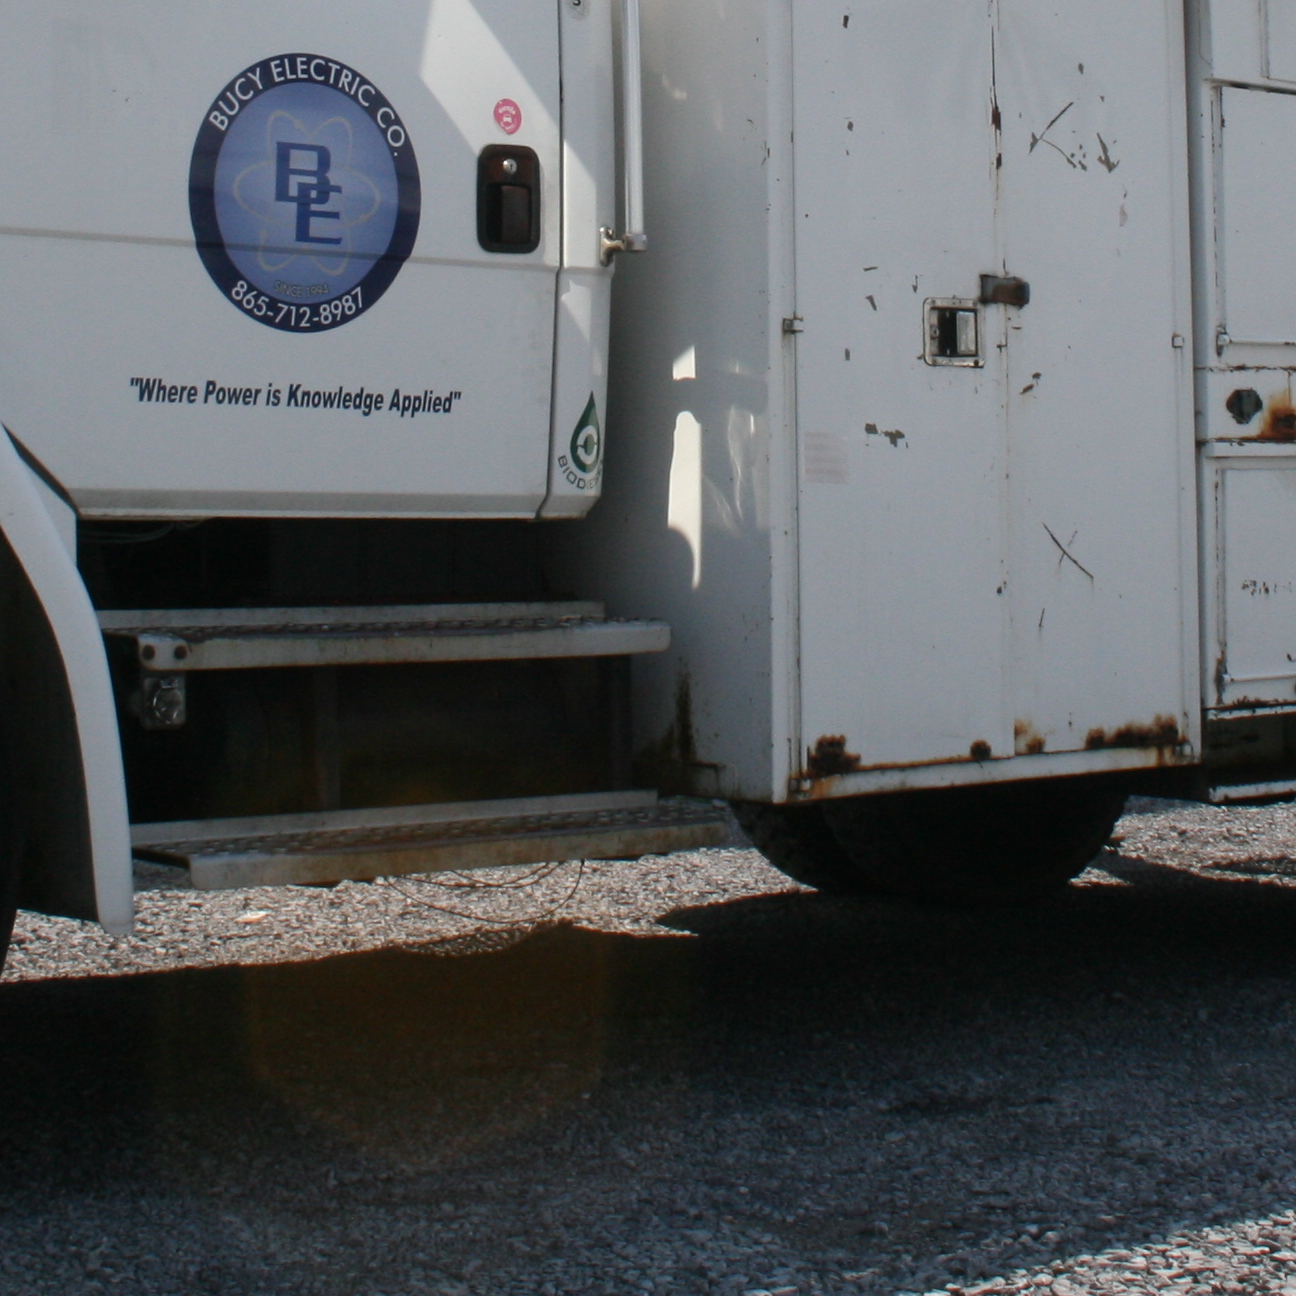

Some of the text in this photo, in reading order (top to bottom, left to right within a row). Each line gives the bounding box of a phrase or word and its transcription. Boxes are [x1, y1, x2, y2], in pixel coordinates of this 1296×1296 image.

[209, 57, 405, 157] BUCY ELECTRIC CO.
[231, 280, 364, 327] 865-712-8987
[274, 281, 303, 298] SINCE
[129, 377, 462, 418] "Where Power is Knowledge Applied"
